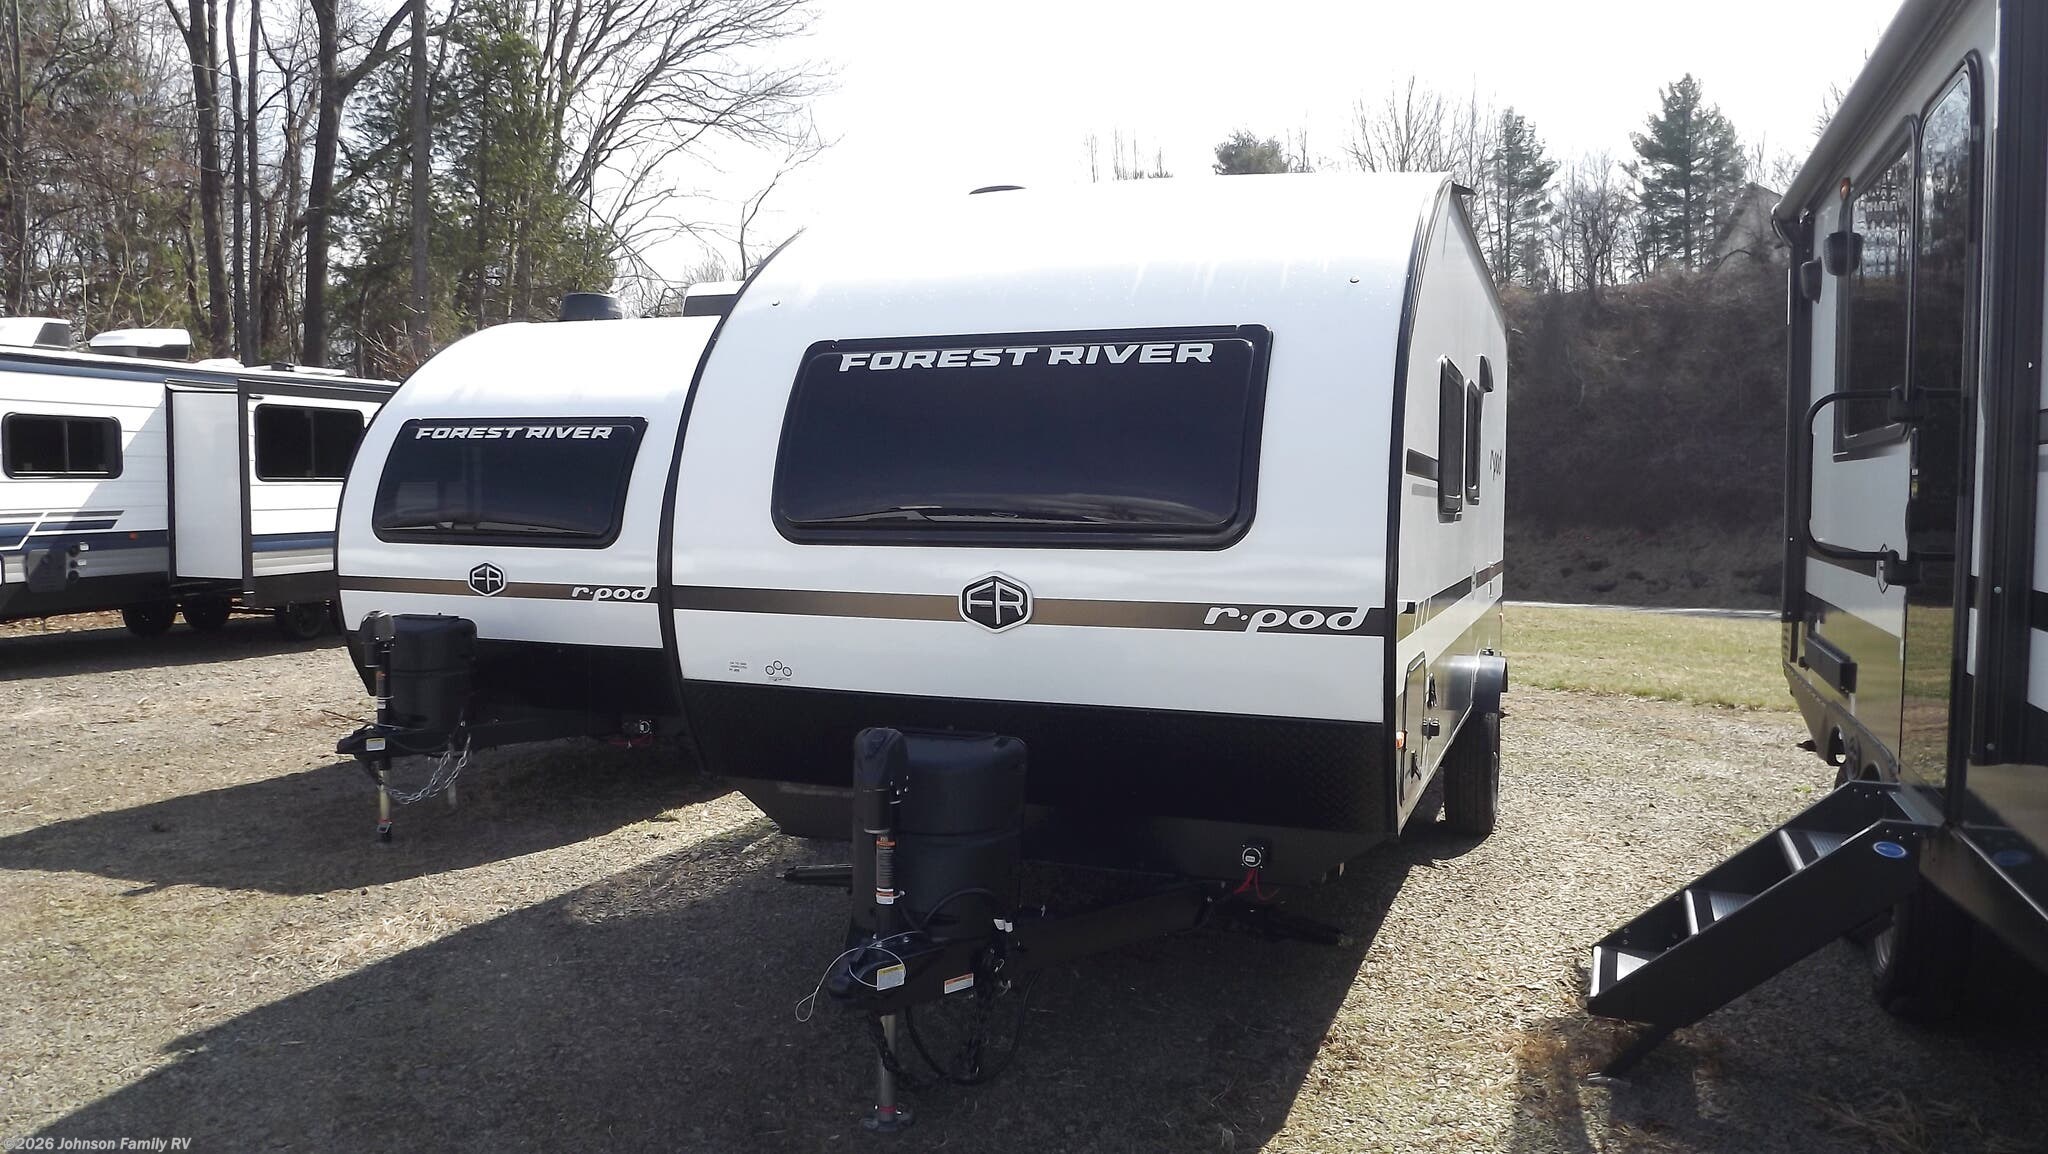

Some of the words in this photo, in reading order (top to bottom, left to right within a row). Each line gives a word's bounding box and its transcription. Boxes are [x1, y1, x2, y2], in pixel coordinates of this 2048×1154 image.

[838, 346, 1039, 372] FOREST
[1047, 342, 1216, 366] RIVER
[415, 426, 523, 440] FOREST
[525, 426, 614, 439] RIVER
